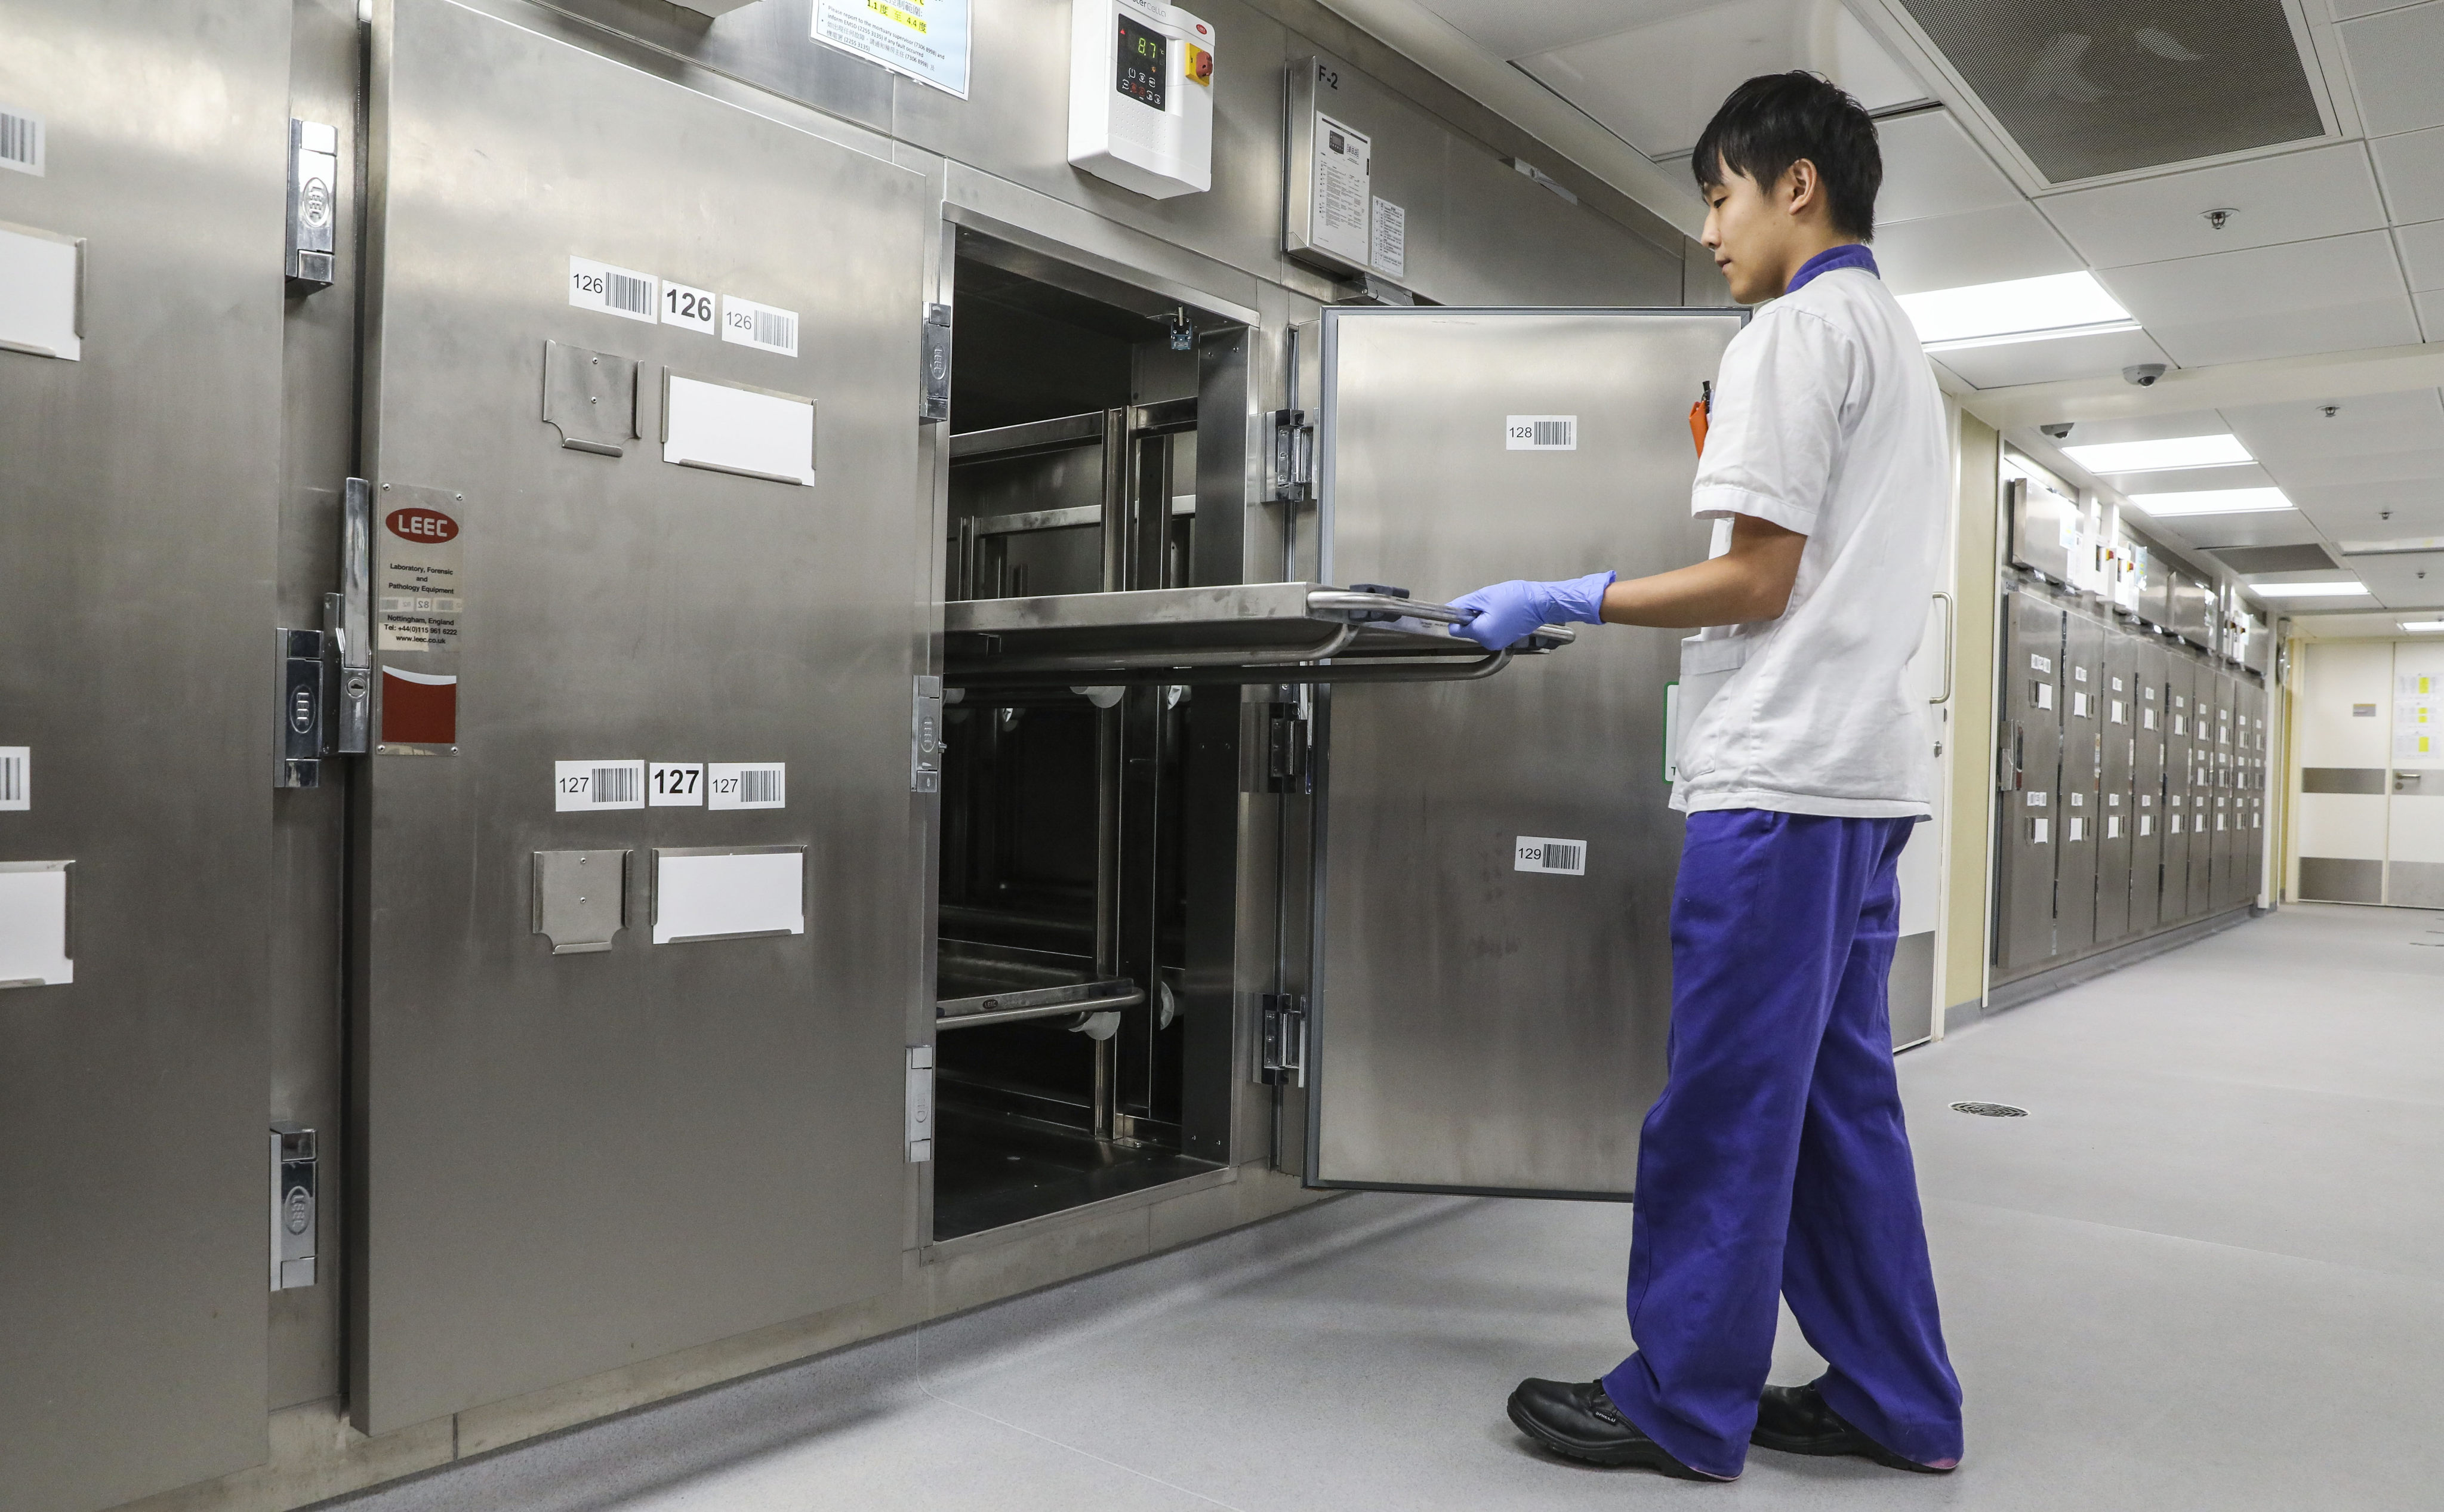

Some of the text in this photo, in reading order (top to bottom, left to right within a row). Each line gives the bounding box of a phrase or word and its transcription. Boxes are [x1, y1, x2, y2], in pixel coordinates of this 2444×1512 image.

[867, 0, 877, 10] 1.1
[893, 10, 901, 21] 至
[907, 17, 917, 27] 4.4
[828, 5, 842, 15] Please
[843, 13, 857, 21] report
[873, 24, 892, 36] mortuary
[893, 33, 914, 45] supervisor
[914, 41, 925, 50] (7306
[828, 13, 843, 23] inform
[844, 20, 857, 29] EMSD
[858, 26, 870, 35] (2255
[871, 30, 883, 41] 3135)
[896, 41, 905, 50] fault
[905, 47, 924, 57] occurred
[844, 36, 856, 45] (2255
[858, 42, 870, 51] 3135)
[1138, 38, 1156, 58] 8.7
[905, 54, 917, 63] (7306
[1319, 64, 1338, 90] F-2
[573, 273, 603, 294] 126
[667, 289, 711, 322] 126
[726, 311, 752, 329] 126
[1509, 427, 1532, 438] 128
[398, 515, 448, 537] LEEC
[390, 563, 426, 573] Laboratory,
[389, 582, 454, 594] Pathology Equipment
[387, 615, 427, 624] Nottingham,
[559, 777, 589, 793] 127
[654, 769, 699, 794] 127
[713, 779, 738, 793] 127
[1518, 848, 1541, 859] 129
